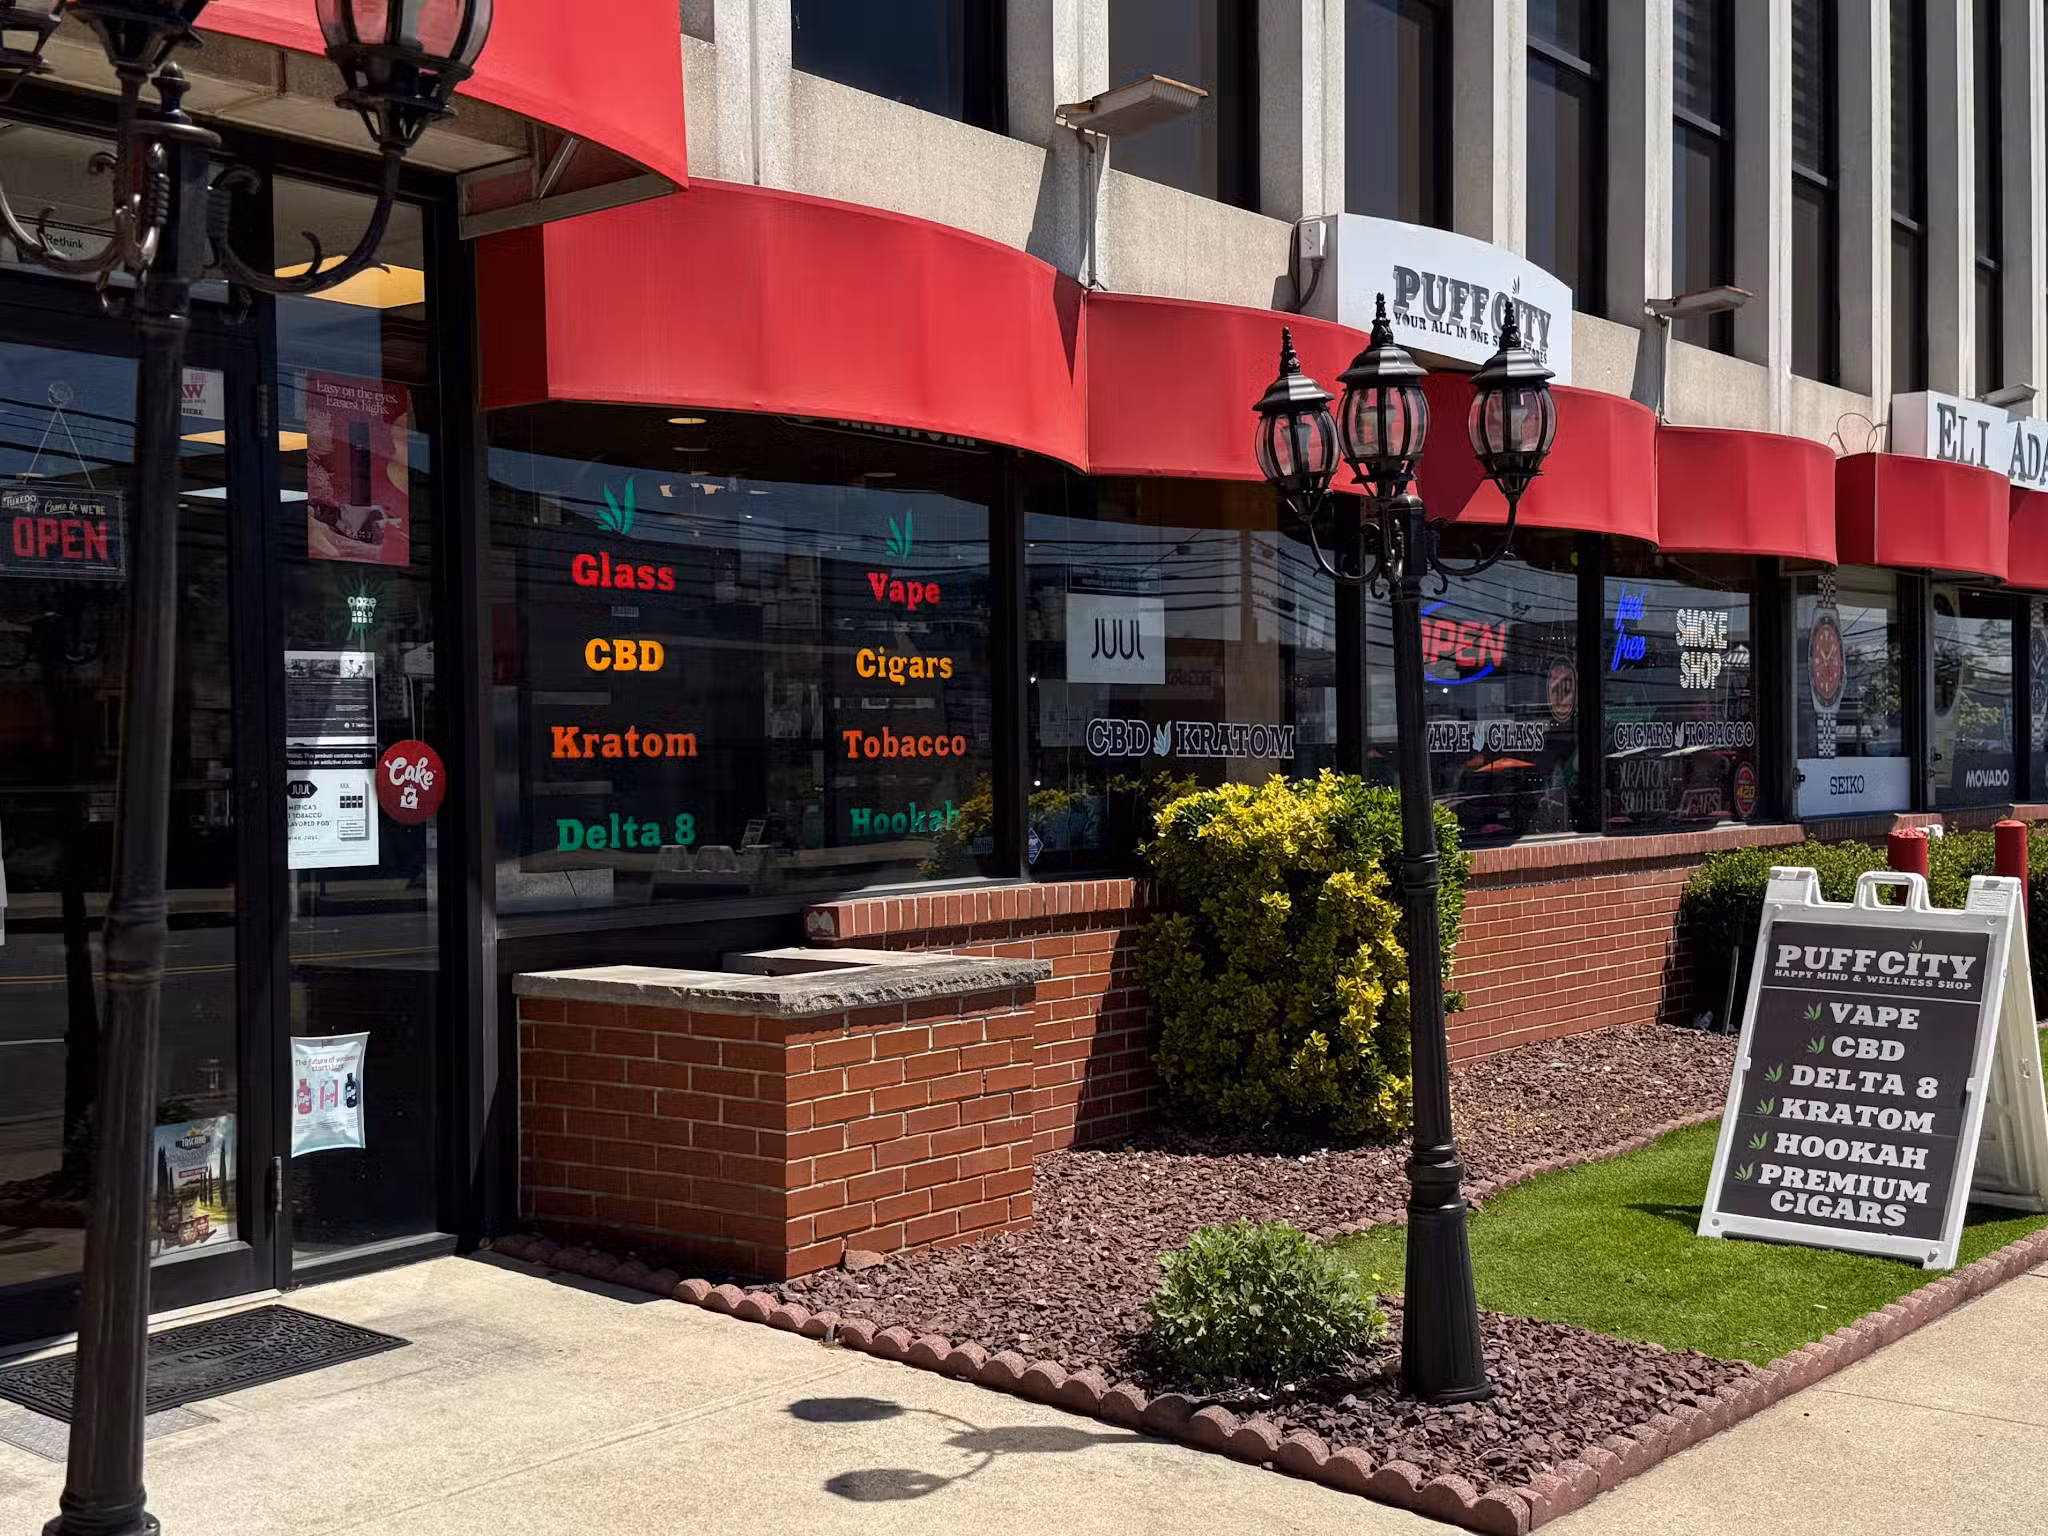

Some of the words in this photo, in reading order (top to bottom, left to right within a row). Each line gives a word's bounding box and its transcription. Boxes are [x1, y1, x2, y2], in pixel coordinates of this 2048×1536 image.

[47, 233, 84, 249] Rethink
[1394, 312, 1427, 330] YOUR
[1431, 321, 1452, 335] ALL
[1456, 326, 1467, 339] IN
[1470, 329, 1489, 346] ONE
[317, 379, 340, 397] Easy
[342, 387, 354, 398] on
[357, 386, 374, 400] the
[326, 395, 359, 410] Easiest
[1937, 402, 1990, 469] ELI
[45, 500, 67, 515] Come
[80, 504, 106, 516] WE'RE
[13, 516, 108, 561] OPEN
[571, 551, 677, 591] Glass
[867, 571, 941, 612] Vape
[1091, 618, 1144, 660] JUUL
[1676, 608, 1728, 649] SMOKE
[585, 638, 665, 672] CBD
[855, 646, 954, 686] Cigars
[1680, 652, 1721, 690] SHOP
[551, 725, 698, 759] Kratom
[842, 726, 967, 759] Tobacco
[1086, 718, 1151, 757] CBD
[1176, 721, 1295, 760] KRATOM
[1487, 721, 1544, 753] GLASS
[1614, 722, 1673, 750] CIGARS
[1685, 721, 1755, 748] TOBACCO
[291, 783, 311, 795] JUUL
[384, 757, 435, 791] Cake
[1829, 774, 1865, 796] SEIKO
[1965, 768, 2010, 789] MOVADO
[556, 812, 662, 852] Delta
[674, 813, 696, 845] 8
[1775, 944, 1977, 980] PUFFCITY
[1774, 969, 1813, 979] HAPPY
[1817, 972, 1849, 982] MIND
[1852, 975, 1861, 983] &
[1866, 975, 1933, 987] WELLNESS
[1937, 980, 1972, 991] SHOP
[1829, 1002, 1920, 1030] VAPE
[1831, 1036, 1905, 1062] CBD
[1790, 1064, 1905, 1096] DELTA
[1915, 1077, 1939, 1099] 8
[1779, 1097, 1936, 1134] KRATOM
[1774, 1132, 1929, 1170] HOOKAH
[1758, 1163, 1931, 1204] PREMIUM
[1770, 1190, 1908, 1227] CIGARS
